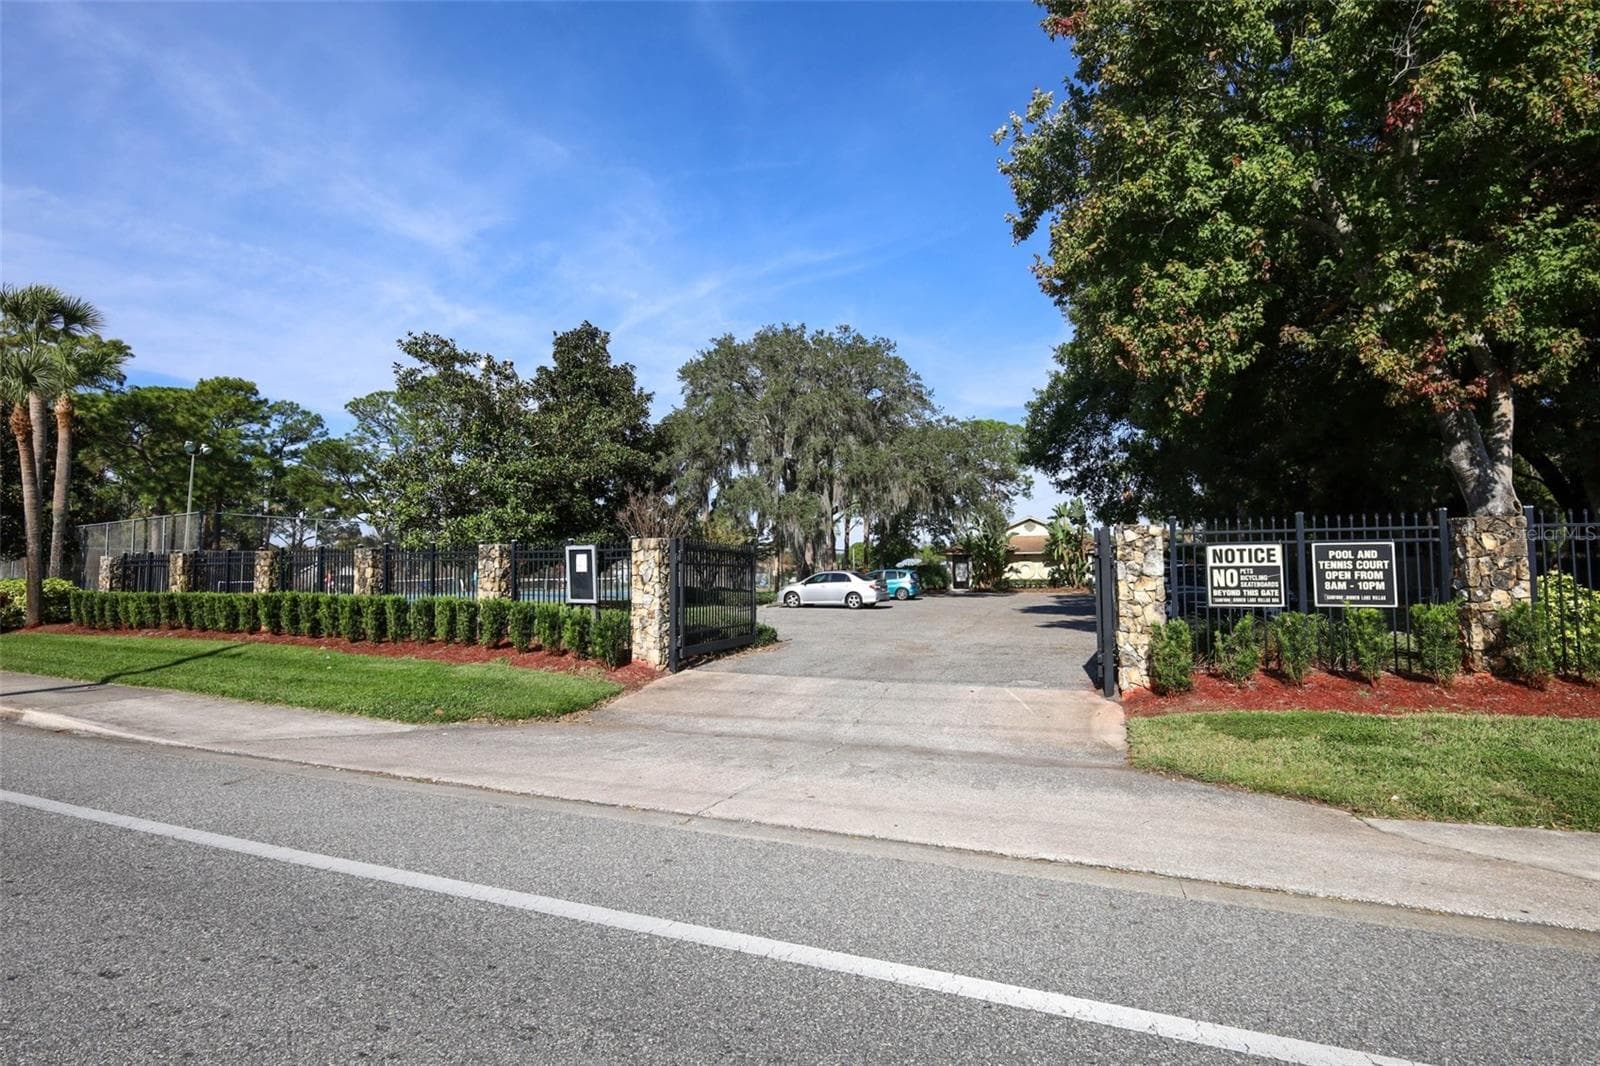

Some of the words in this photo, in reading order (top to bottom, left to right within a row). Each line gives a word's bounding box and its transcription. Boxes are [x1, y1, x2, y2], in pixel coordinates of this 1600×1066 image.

[1212, 548, 1277, 563] NOTICE
[1328, 550, 1354, 559] POOL
[1357, 549, 1378, 559] AND
[1318, 560, 1353, 569] TENNIS
[1355, 560, 1390, 569] COURT
[1212, 568, 1239, 587] NO
[1325, 571, 1351, 580] OPEN
[1354, 571, 1384, 580] FROM
[1324, 581, 1347, 590] 8AM
[1357, 581, 1386, 590] 10PM
[1212, 589, 1241, 597] BEYOND
[1242, 589, 1259, 597] THIS
[1260, 589, 1279, 597] GATE
